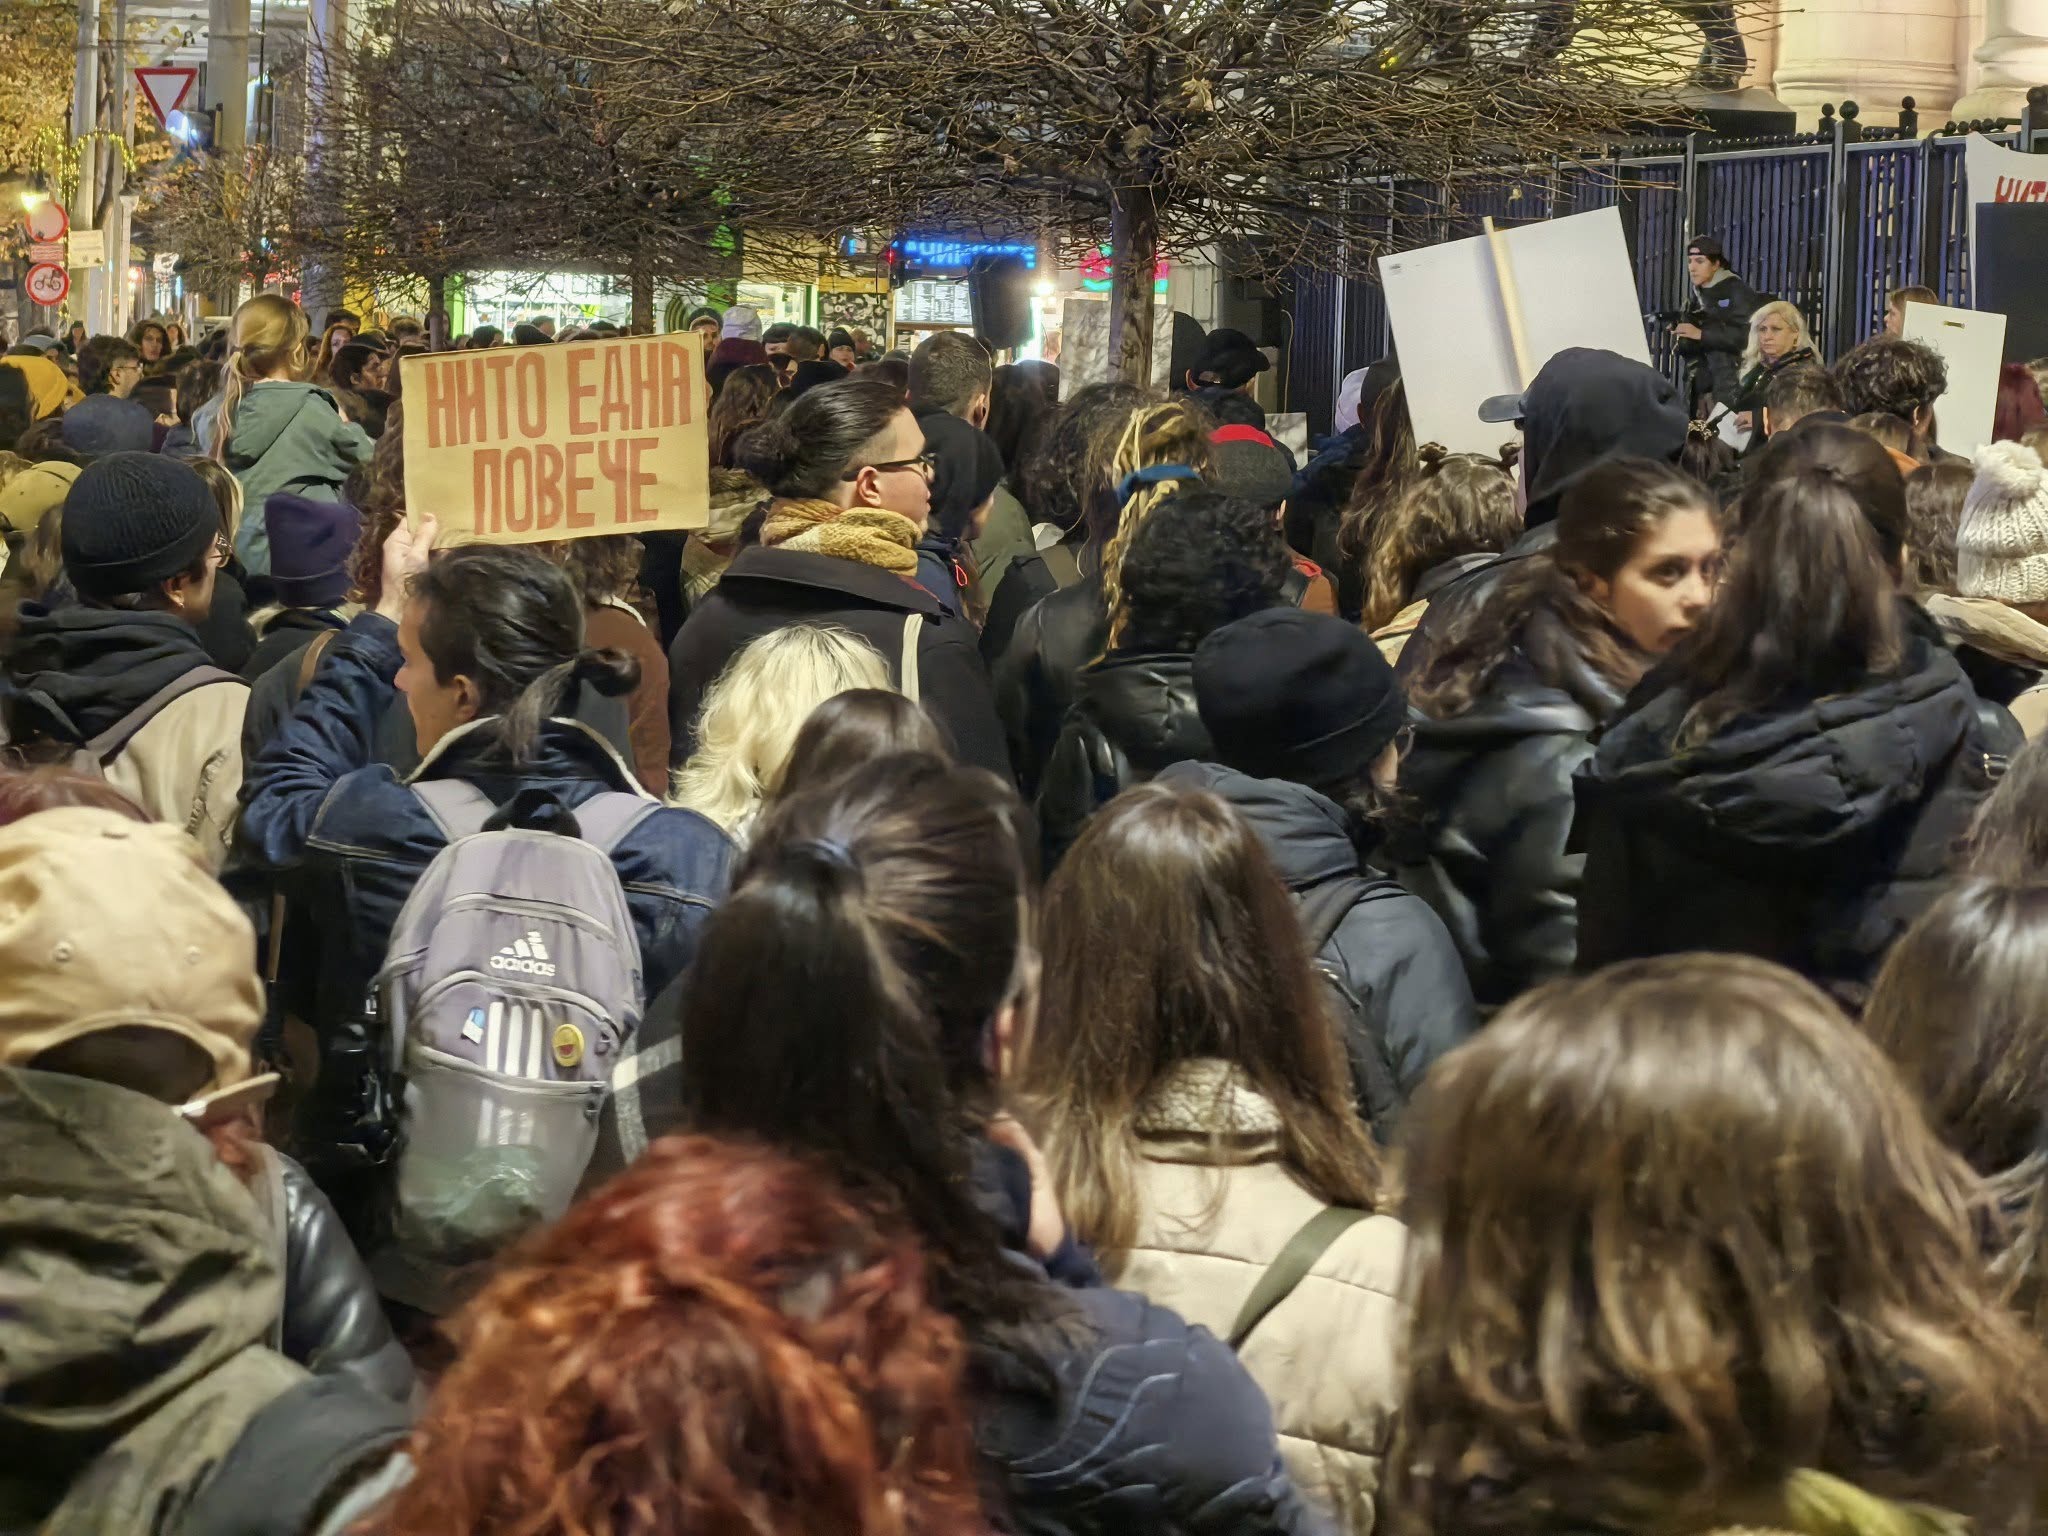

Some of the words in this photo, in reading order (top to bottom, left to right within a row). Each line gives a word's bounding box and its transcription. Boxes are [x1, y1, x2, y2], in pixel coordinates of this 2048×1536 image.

[424, 352, 547, 448] НИТО
[566, 342, 691, 435] ЕДНА
[473, 437, 659, 535] ПОВЕЧЕ
[490, 955, 555, 976] adidas
